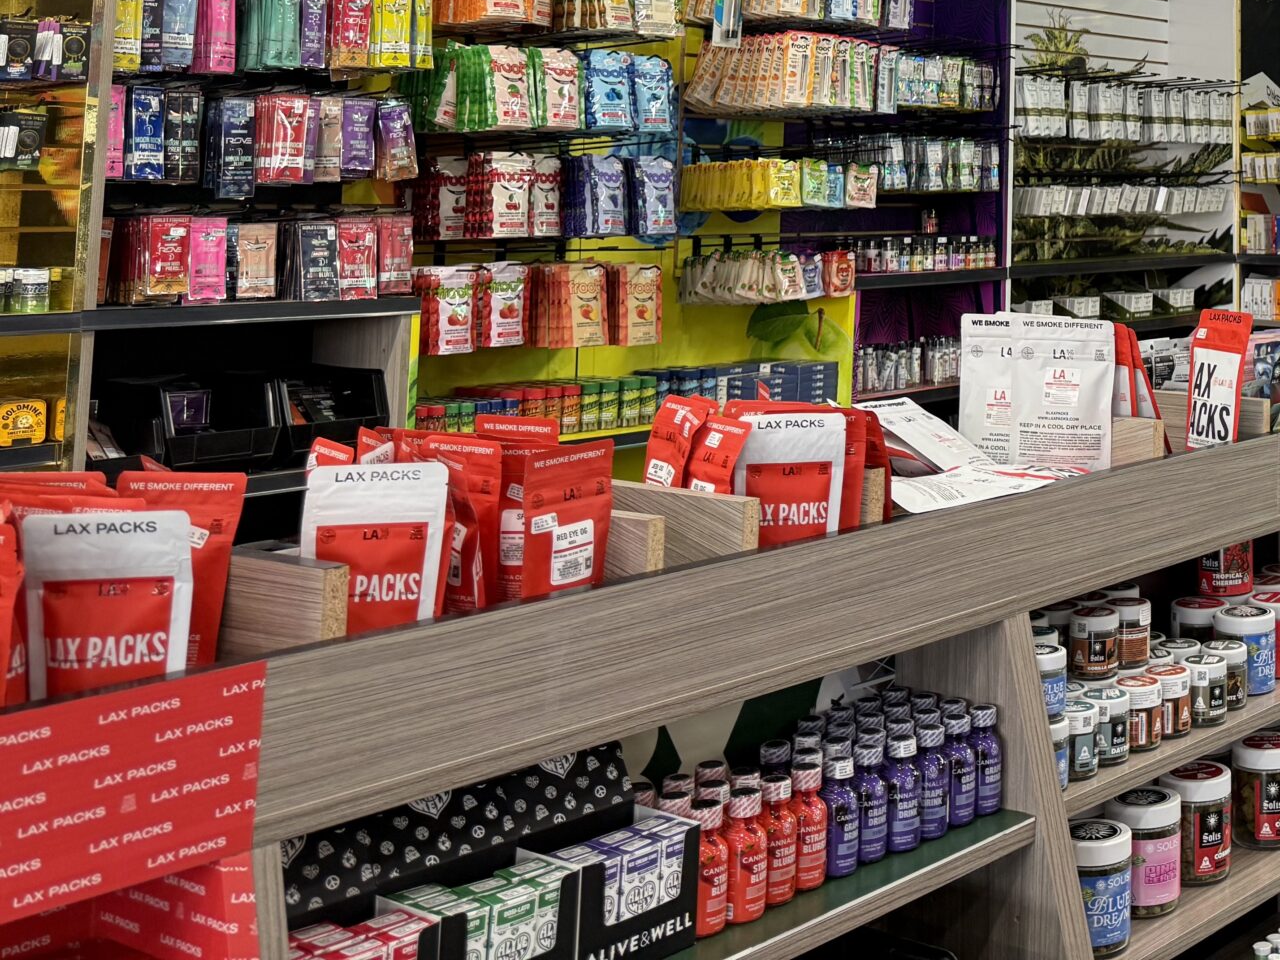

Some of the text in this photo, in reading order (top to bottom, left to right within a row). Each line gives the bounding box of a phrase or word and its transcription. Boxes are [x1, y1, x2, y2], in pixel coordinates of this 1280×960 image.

[984, 320, 1010, 328] SMOKE
[1036, 321, 1063, 329] SMOKE
[1064, 322, 1104, 330] DIFFERENT
[1193, 362, 1217, 400] AX
[2, 403, 43, 421] GOLDMINE
[1189, 400, 1231, 442] ACKS
[495, 423, 518, 432] SMOKE
[519, 425, 551, 434] DIFFERENT
[440, 443, 495, 456] SMOKE DIFFERENT
[533, 448, 606, 470] WE SMOKE DIFFERENT
[129, 480, 236, 492] WE SMOKE DIFFERENT
[335, 469, 422, 483] LAX PACKS
[53, 520, 158, 536] LAX PACKS
[556, 532, 568, 542] RED
[568, 529, 579, 540] EYE
[353, 572, 422, 604] PACKS
[1212, 572, 1244, 583] TROPICAL
[1212, 579, 1243, 590] CHERRIES
[85, 631, 168, 669] PACKS
[99, 698, 180, 725] LAX PACKS
[155, 716, 233, 743] LAX PACKS
[22, 745, 110, 775] LAX PACKS
[94, 760, 176, 789] LAX PACKS
[151, 774, 230, 803] LAX PACKS
[17, 807, 106, 839] LAX PACKS
[89, 822, 172, 854] LAX PACKS
[147, 837, 226, 868] LAX PACKS
[13, 873, 102, 909] LAX PACKS
[1087, 890, 1130, 916] BLUE
